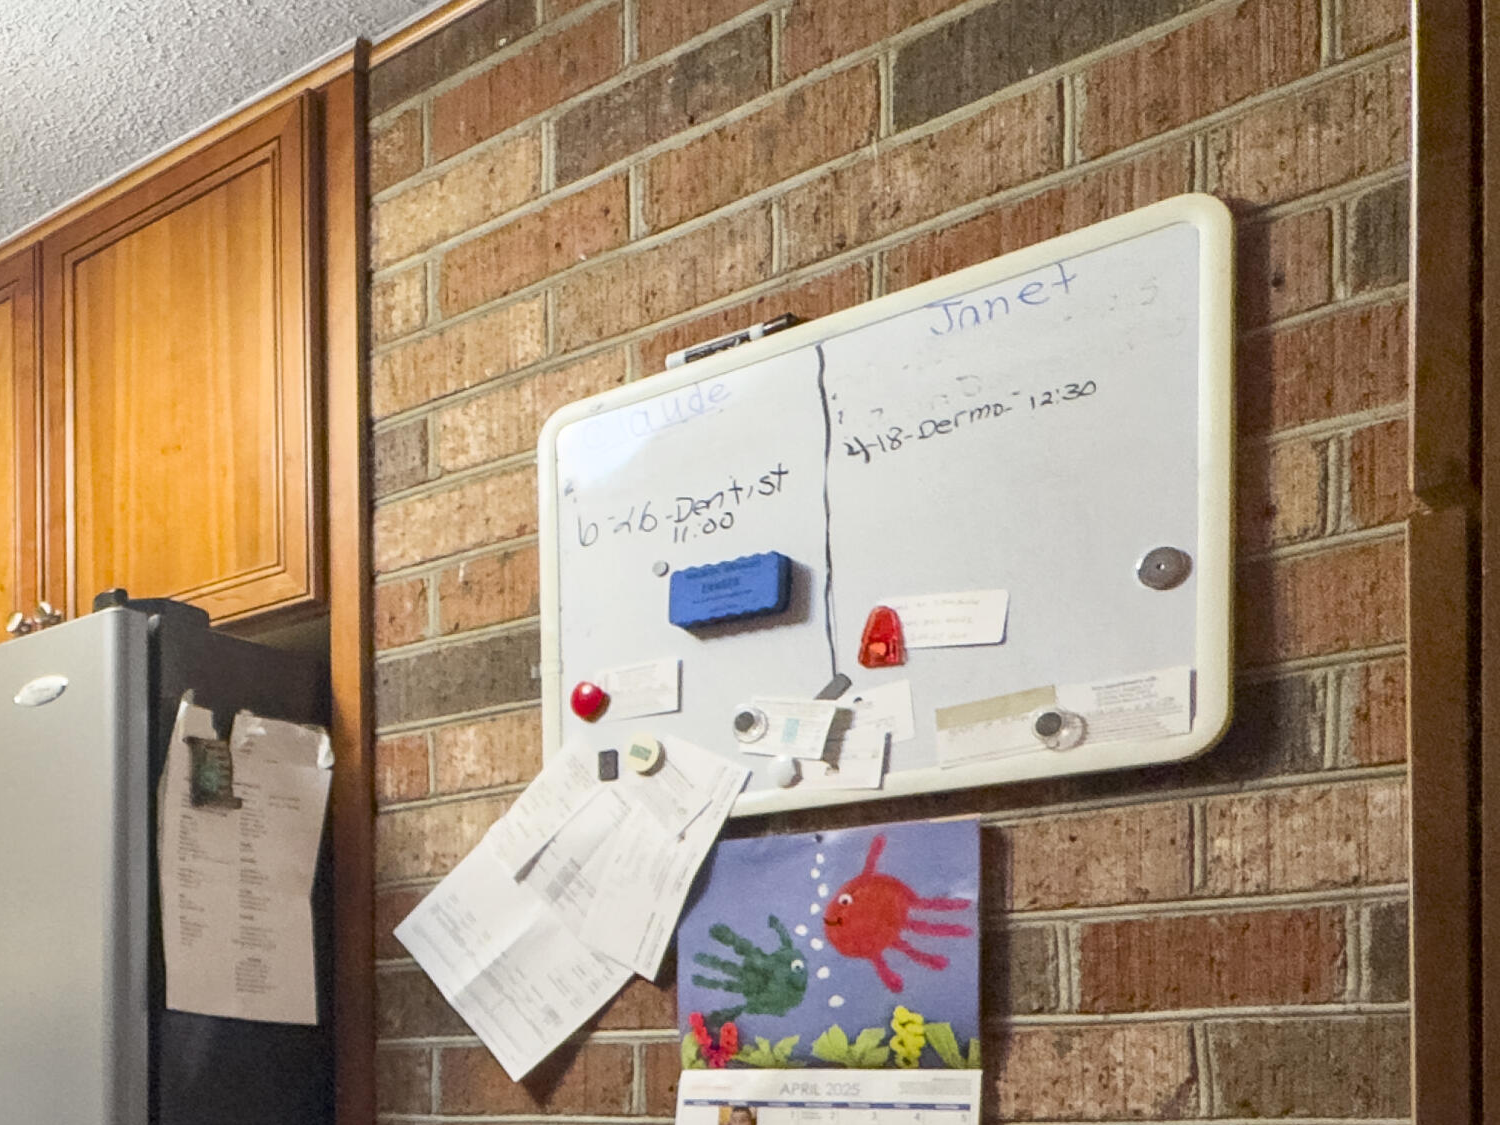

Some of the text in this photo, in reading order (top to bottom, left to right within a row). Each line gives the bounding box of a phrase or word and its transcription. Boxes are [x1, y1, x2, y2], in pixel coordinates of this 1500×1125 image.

[673, 511, 734, 543] 11:00
[779, 1081, 861, 1097] APRIL 2025
